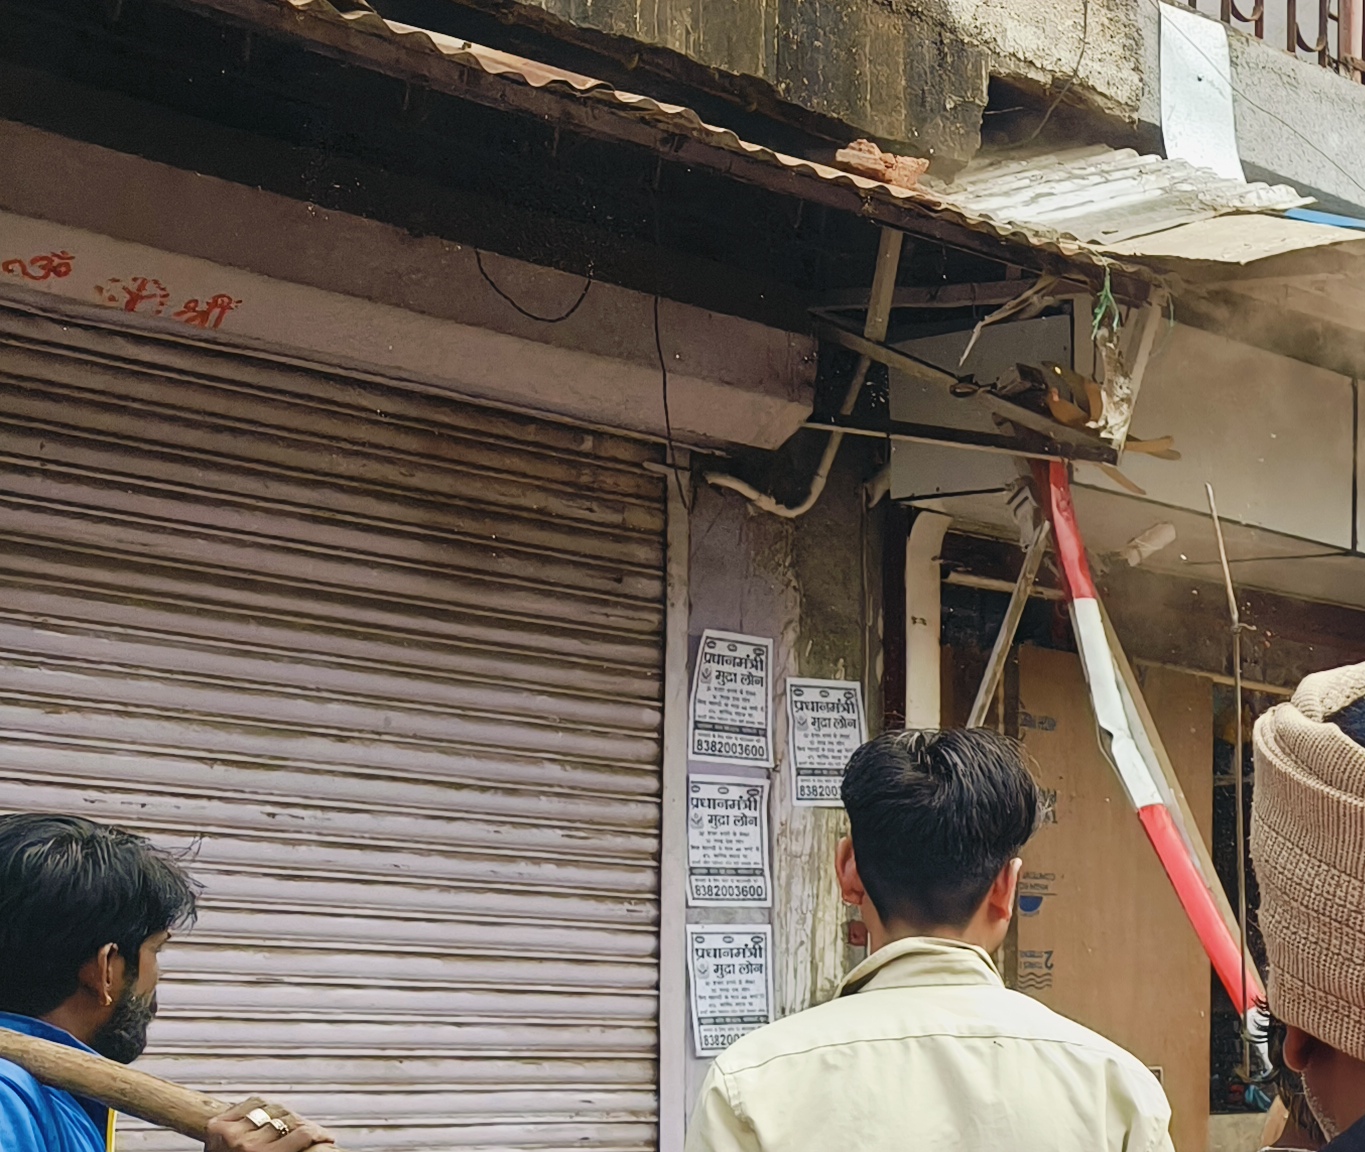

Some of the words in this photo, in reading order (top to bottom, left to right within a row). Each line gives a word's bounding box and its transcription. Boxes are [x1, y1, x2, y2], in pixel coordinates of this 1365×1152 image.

[703, 652, 764, 672] प्रधानमंत्री
[715, 669, 738, 686] मुद्रा
[740, 671, 764, 687] लोन
[794, 698, 856, 714] प्रधानमंत्री
[811, 716, 831, 732] मुद्रा
[833, 715, 857, 729] लोन
[696, 739, 765, 757] 8382003600
[690, 795, 758, 811] प्रधानमंत्री
[707, 813, 730, 830] मुद्रा
[733, 812, 758, 827] लोन
[695, 884, 763, 898] 8382003600
[695, 943, 763, 961] प्रधानमंत्री
[713, 963, 736, 979] मुद्रा
[738, 961, 763, 975] लोन
[703, 1033, 746, 1047] 838200
